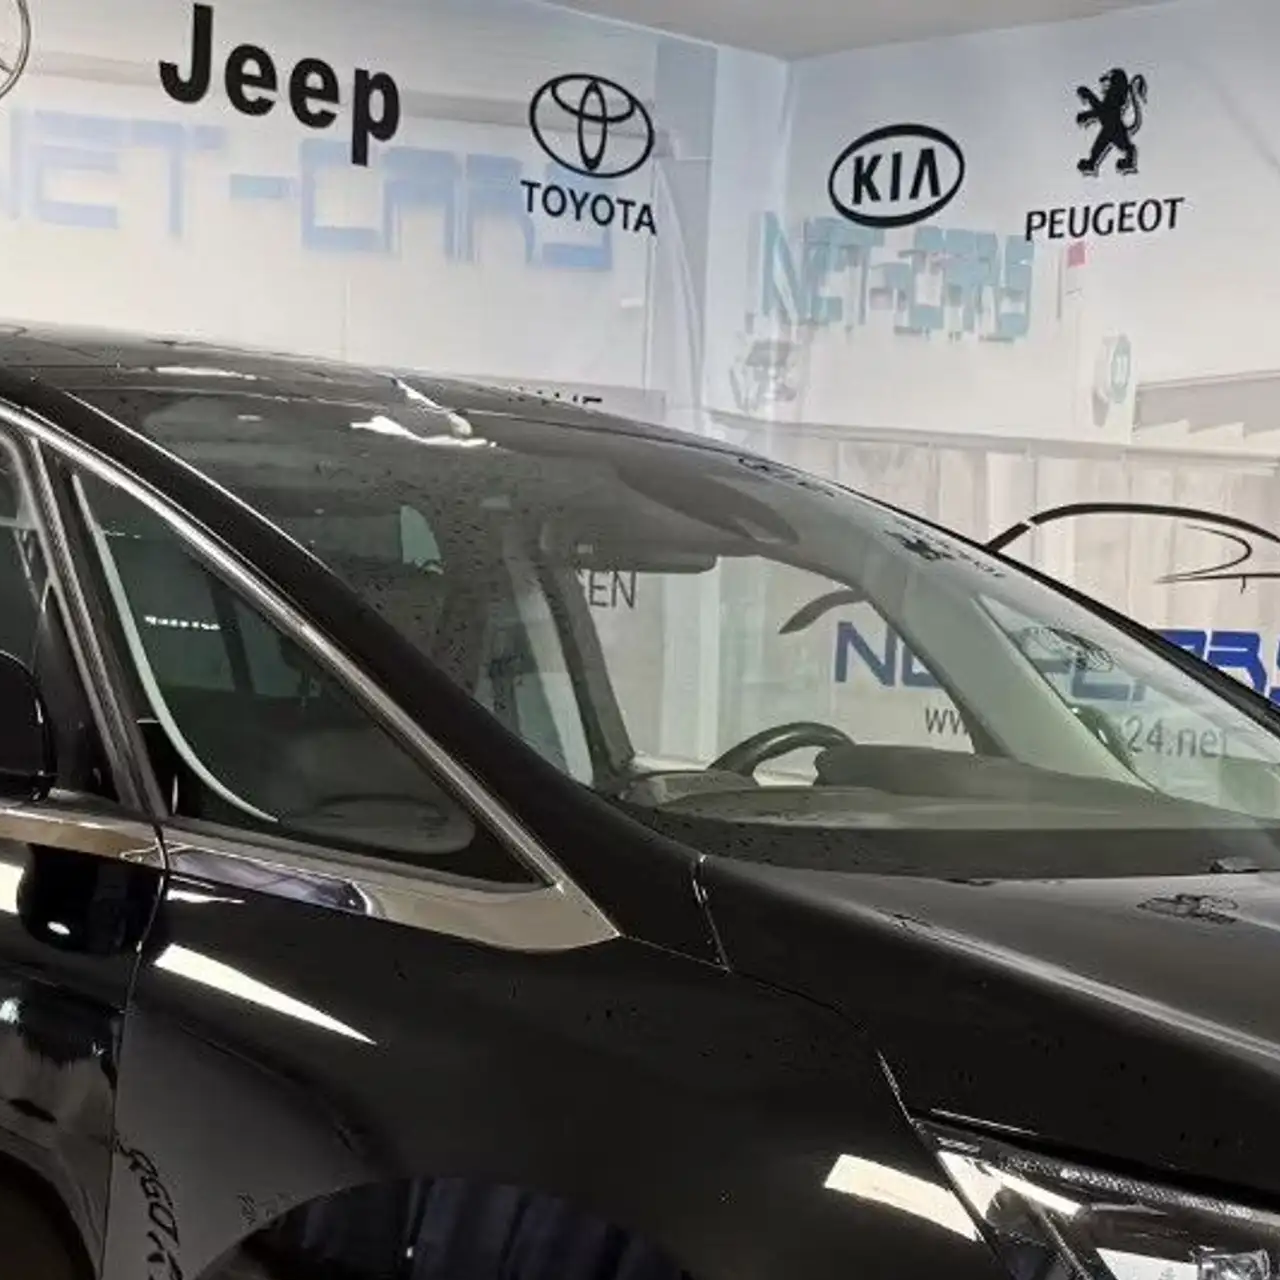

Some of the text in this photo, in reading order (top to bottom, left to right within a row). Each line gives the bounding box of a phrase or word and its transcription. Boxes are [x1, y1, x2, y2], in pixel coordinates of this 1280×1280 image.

[159, 3, 401, 166] Jeep
[851, 148, 942, 205] KIA
[520, 180, 657, 236] TOYOTA
[1024, 197, 1186, 242] PEUGEOT
